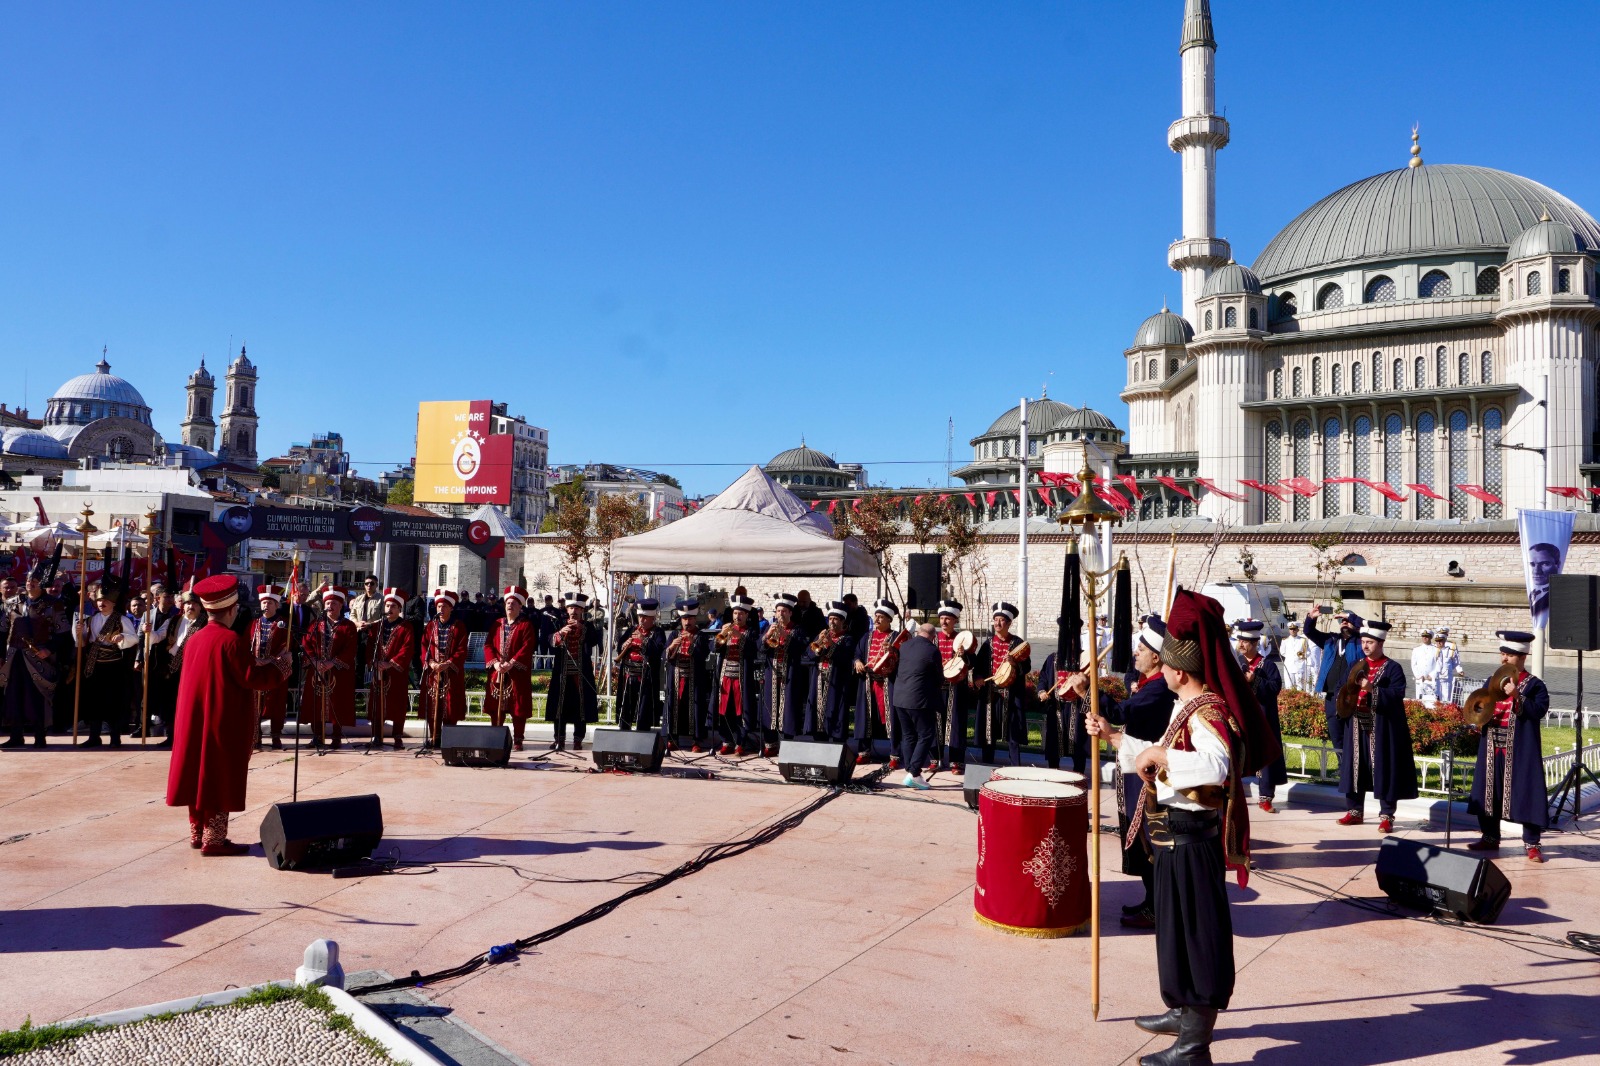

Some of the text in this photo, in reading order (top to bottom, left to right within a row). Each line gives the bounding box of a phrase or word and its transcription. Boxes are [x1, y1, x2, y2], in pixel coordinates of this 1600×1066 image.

[468, 413, 484, 421] ARE
[434, 486, 498, 494] THE CHAMPIONS
[293, 524, 313, 532] KUTLU
[314, 525, 334, 533] OLSUN
[426, 523, 463, 531] ANNIVERSARY
